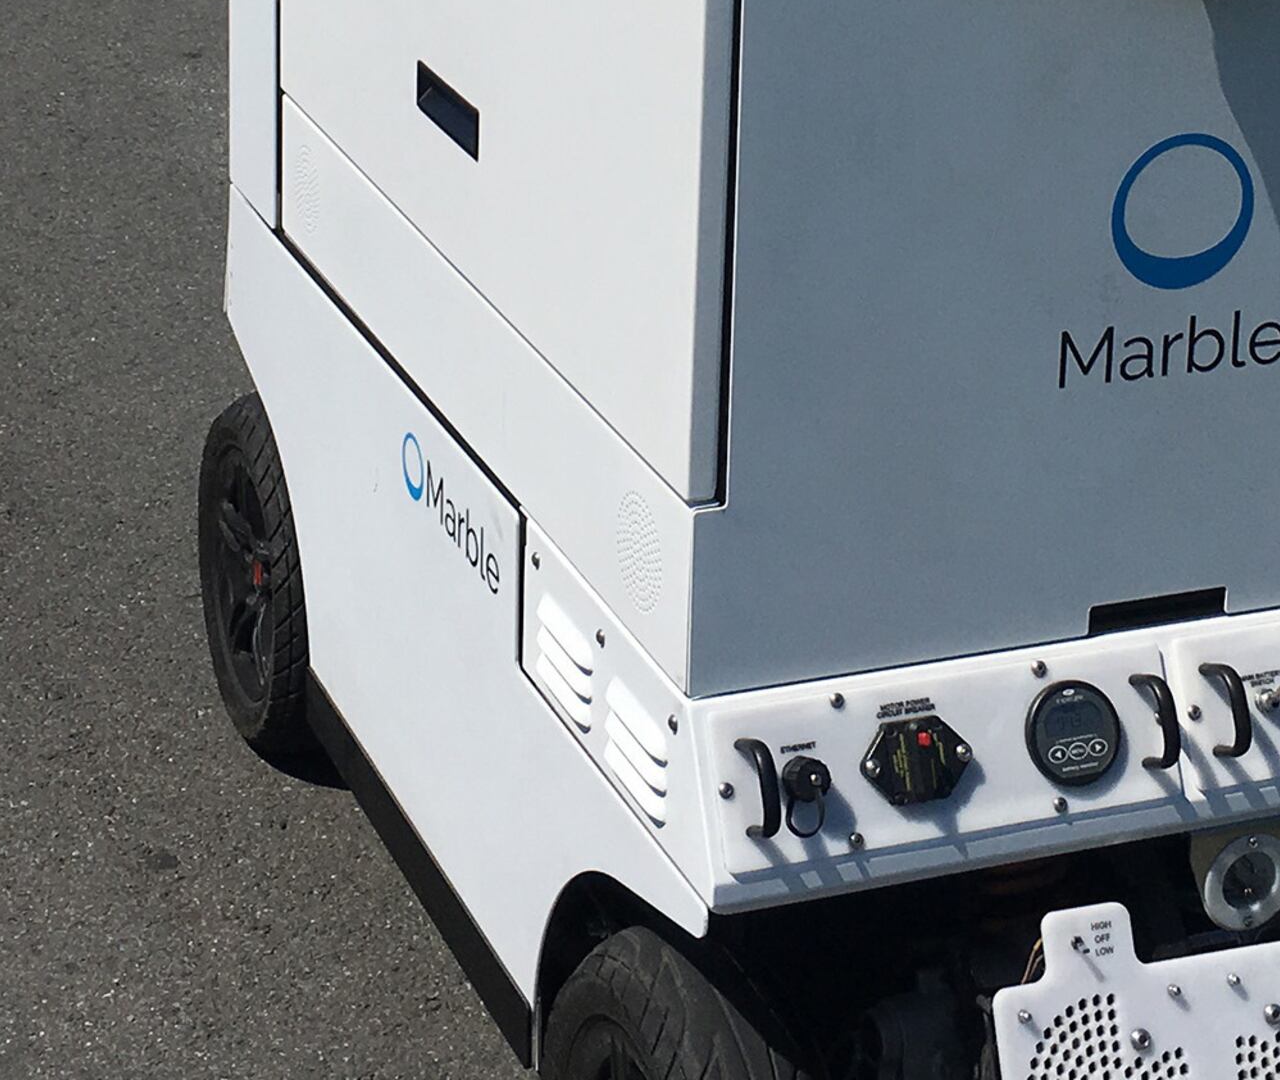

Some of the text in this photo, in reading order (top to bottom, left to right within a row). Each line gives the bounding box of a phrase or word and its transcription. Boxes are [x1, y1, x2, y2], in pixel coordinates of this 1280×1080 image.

[426, 459, 500, 595] Marble
[905, 697, 930, 706] POWER
[780, 740, 817, 754] ETHERNET
[1091, 920, 1112, 931] HIGH
[1094, 933, 1111, 943] OFF
[1095, 945, 1114, 956] LOW
